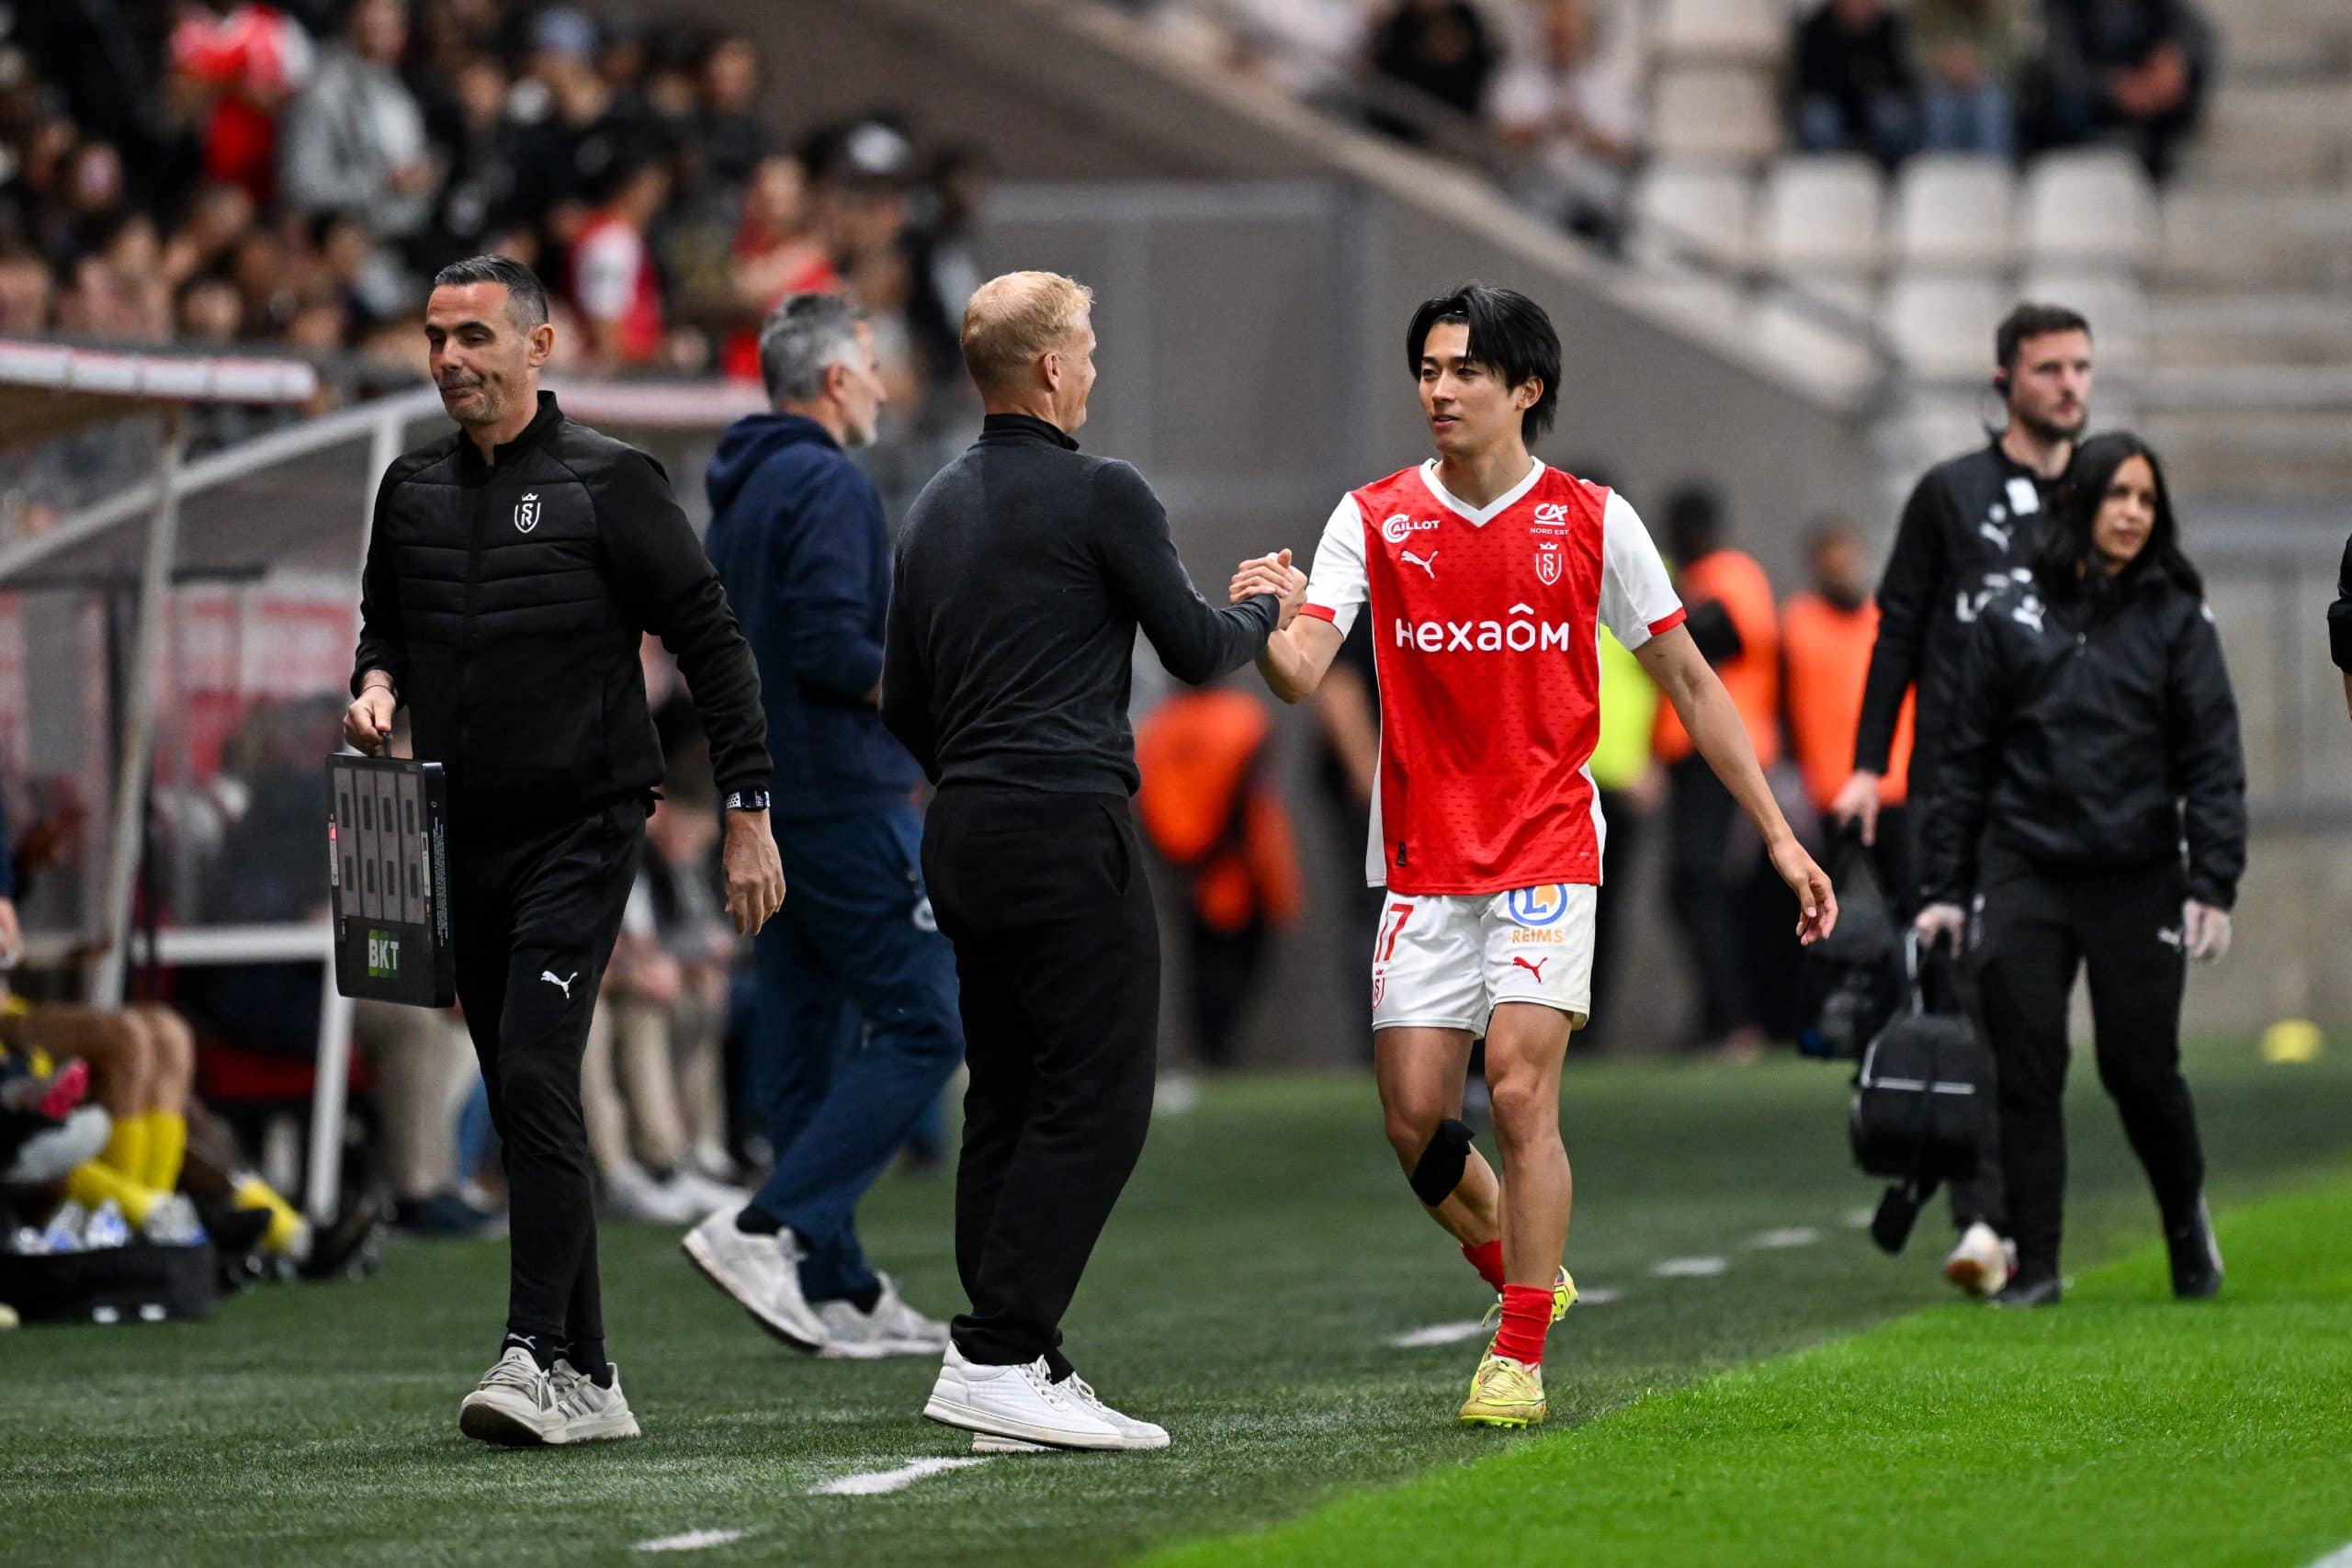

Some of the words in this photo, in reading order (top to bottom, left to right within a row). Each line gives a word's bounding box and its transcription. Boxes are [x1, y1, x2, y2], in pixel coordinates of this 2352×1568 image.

[1382, 513, 1441, 543] CAILLOT
[1511, 928, 1566, 944] REIMS
[368, 939, 400, 970] BKT
